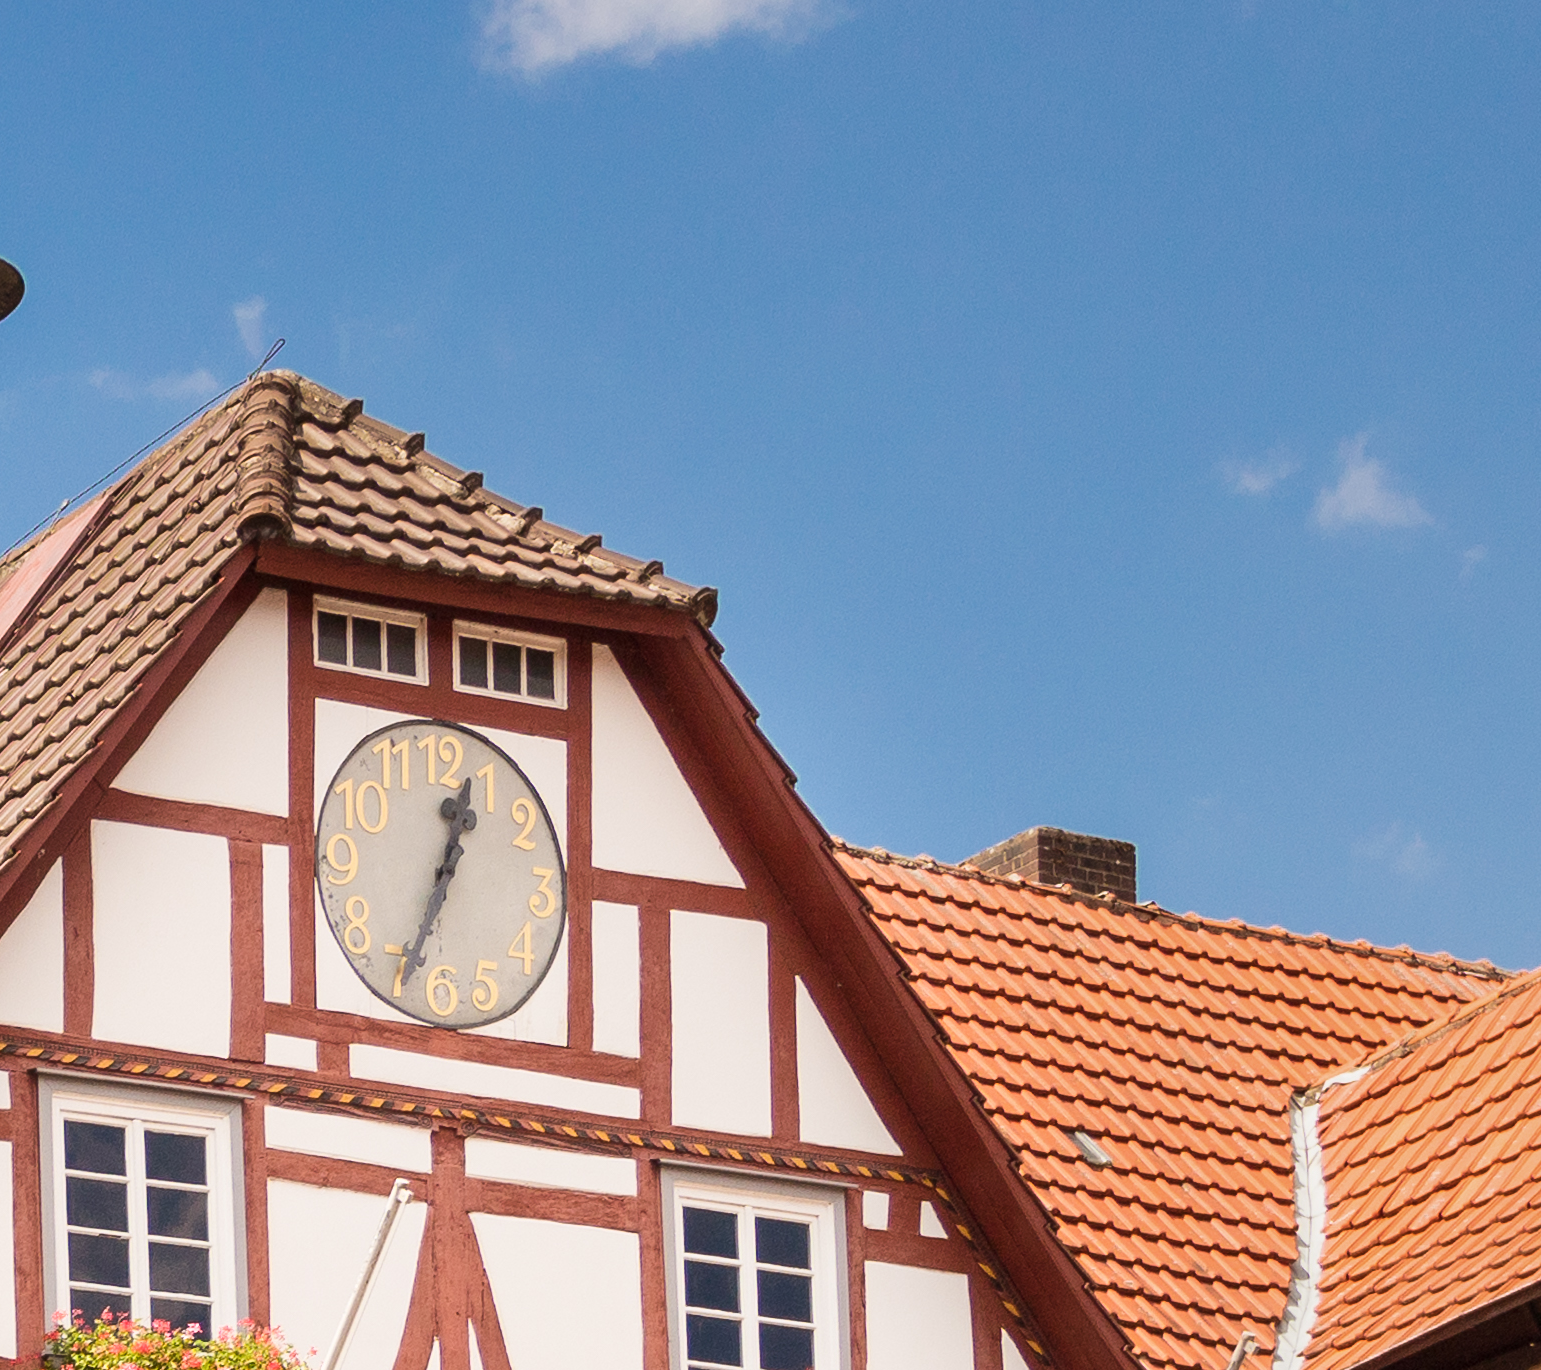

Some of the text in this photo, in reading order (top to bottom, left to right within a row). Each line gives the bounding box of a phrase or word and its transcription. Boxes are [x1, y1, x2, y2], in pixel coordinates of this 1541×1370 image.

[371, 738, 410, 791] 11
[417, 734, 464, 789] 12
[334, 778, 389, 834] 10
[475, 763, 496, 814] 1
[510, 797, 538, 851] 2
[325, 833, 359, 886] 9
[528, 867, 556, 919] 3
[343, 895, 372, 956] 8
[508, 921, 536, 975] 4
[384, 943, 409, 998] 7
[425, 964, 458, 1017] 6
[471, 960, 499, 1012] 5
